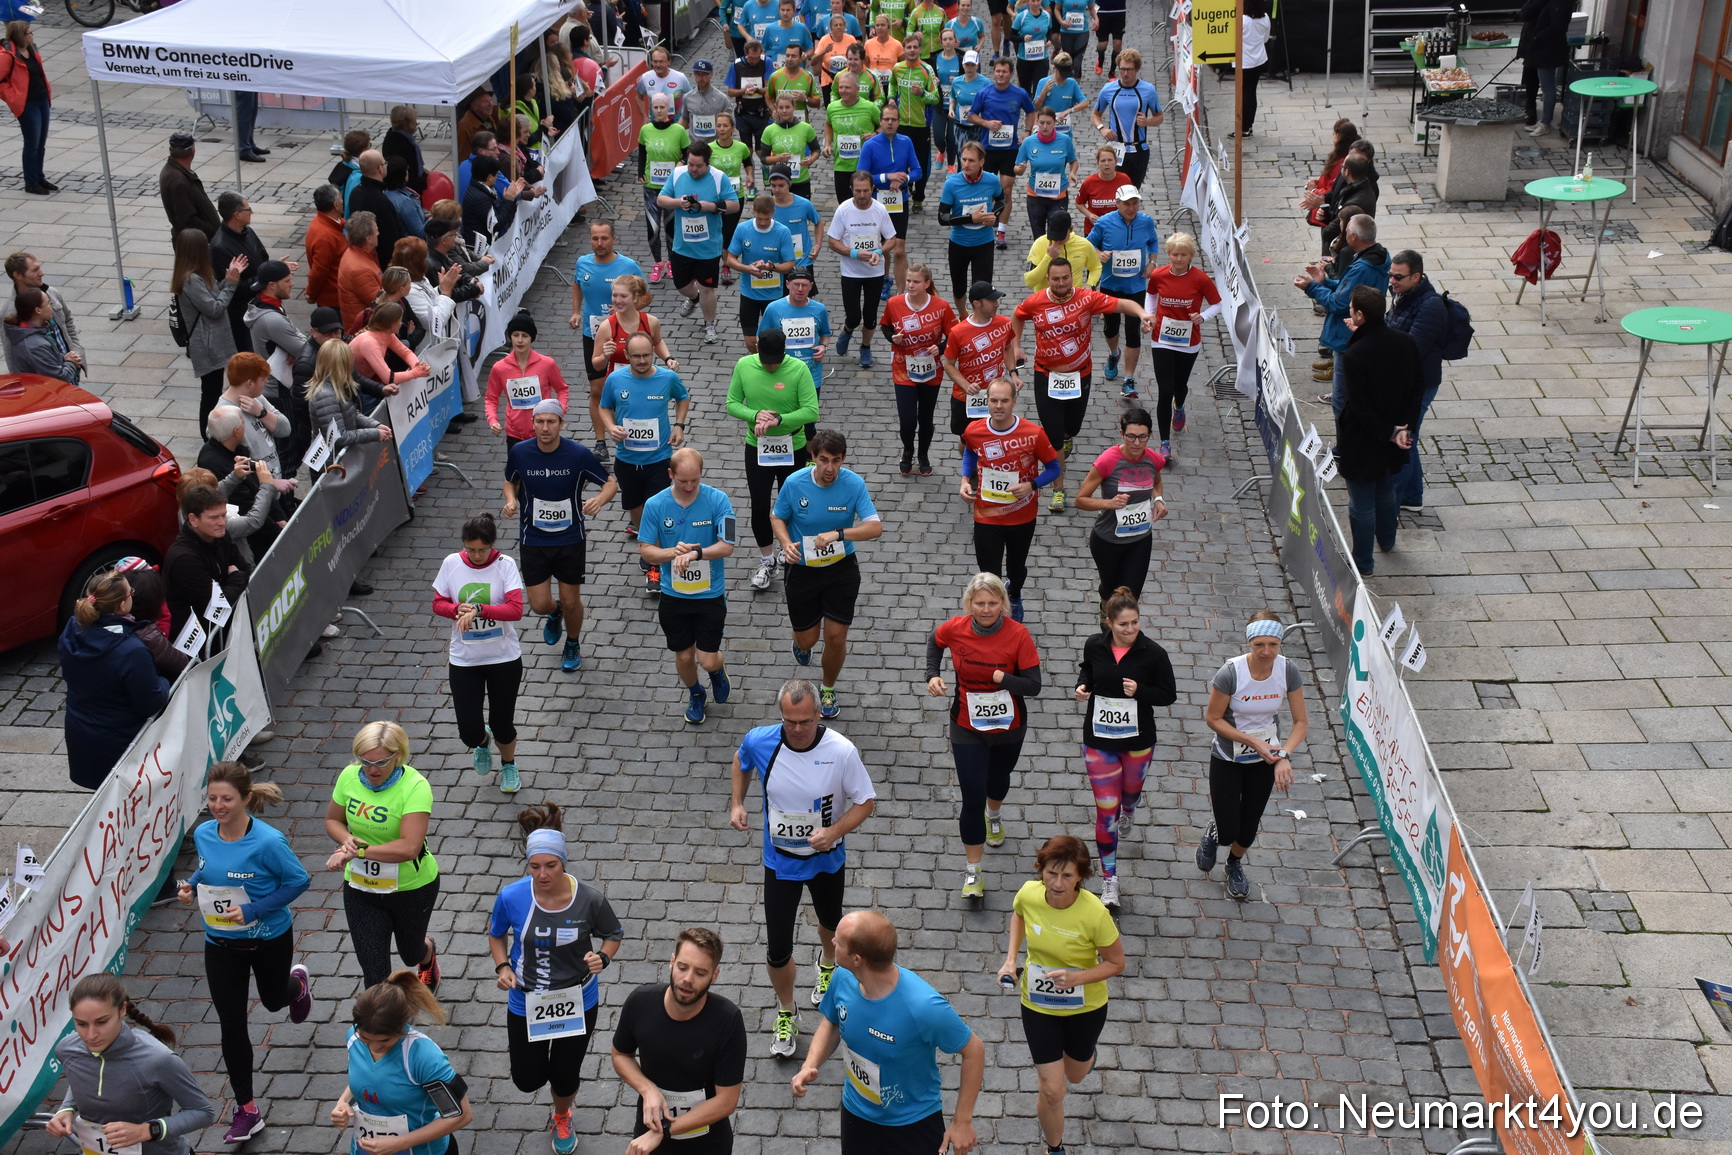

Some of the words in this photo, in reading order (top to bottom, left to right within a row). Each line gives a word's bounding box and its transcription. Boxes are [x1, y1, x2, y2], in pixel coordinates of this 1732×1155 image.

[1194, 7, 1236, 22] Jugend
[1207, 22, 1229, 34] lauf
[102, 42, 150, 60] BMW
[156, 47, 294, 70] ConnectedDrive
[105, 62, 160, 77] Vernetzt,
[163, 68, 182, 77] um
[184, 67, 204, 78] frei
[206, 71, 220, 80] zu
[223, 71, 252, 82] sein.
[654, 168, 672, 176] 2075
[1038, 180, 1057, 189] 2447
[883, 196, 897, 204] 302
[685, 224, 704, 232] 2108
[854, 240, 875, 250] 2458
[1116, 258, 1137, 267] 2199
[763, 270, 774, 279] 96
[788, 327, 811, 338] 2323
[1165, 326, 1188, 336] 2507
[910, 364, 932, 373] 2118
[1053, 380, 1076, 389] 2505
[512, 386, 536, 398] 2450
[628, 428, 654, 439] 2029
[310, 445, 324, 465] swn
[762, 444, 788, 454] 2493
[990, 480, 1010, 492] 167
[538, 510, 566, 520] 2590
[1122, 512, 1148, 526] 2632
[308, 522, 334, 564] OFFIC
[814, 544, 836, 558] 184
[259, 562, 306, 654] BOCK
[468, 618, 496, 630] 178
[184, 628, 199, 650] swn
[1408, 642, 1422, 665] swn
[974, 704, 1008, 717] 2529
[1100, 709, 1130, 724] 2034
[348, 798, 389, 824] EKS
[777, 823, 814, 837] 2132
[364, 860, 380, 876] 19
[213, 900, 232, 914] 67
[534, 1001, 576, 1020] 2482
[548, 1022, 566, 1030] Jenny
[868, 1027, 894, 1042] BOCK
[1496, 1028, 1506, 1045] die
[1500, 1010, 1524, 1059] Neumarkts
